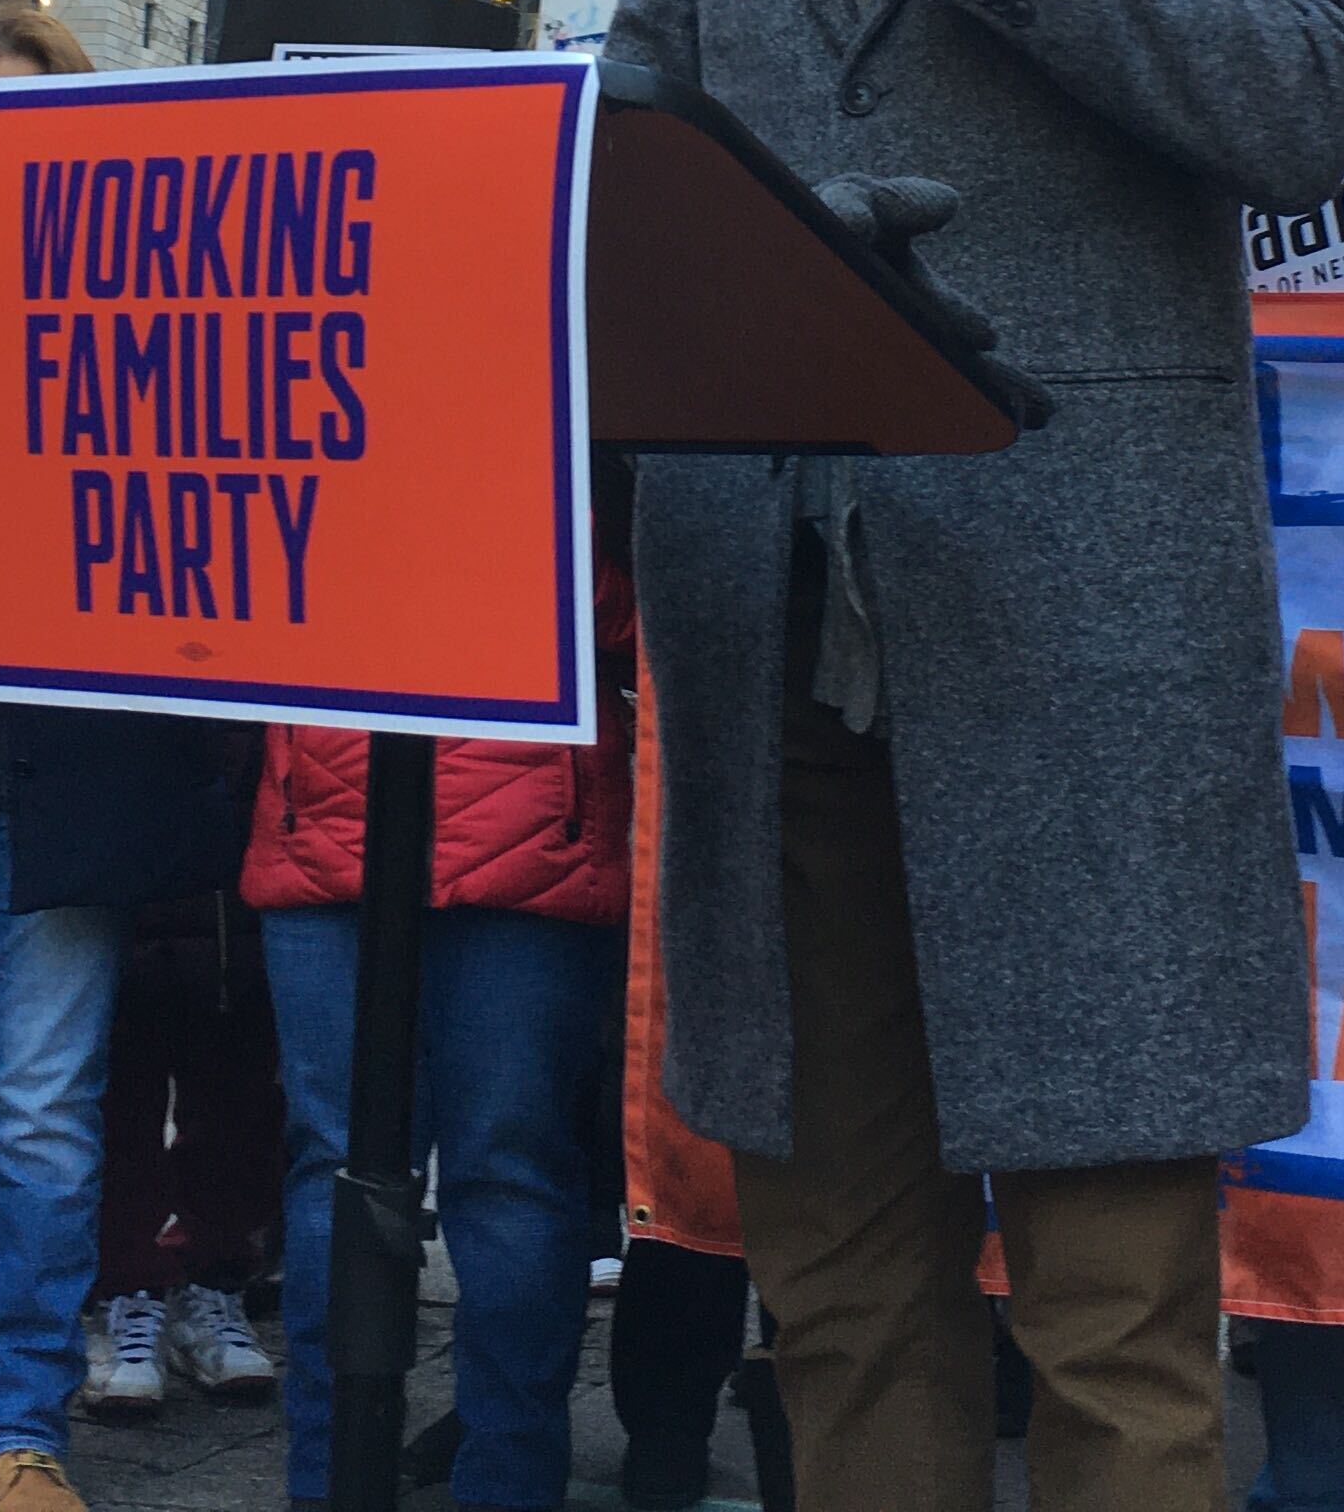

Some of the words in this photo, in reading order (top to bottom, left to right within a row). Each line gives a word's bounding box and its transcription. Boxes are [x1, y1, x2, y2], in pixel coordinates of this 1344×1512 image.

[22, 149, 376, 300] WORKING
[1277, 271, 1302, 293] OF
[26, 311, 366, 461] FAMILIES
[72, 469, 320, 624] PARTY
